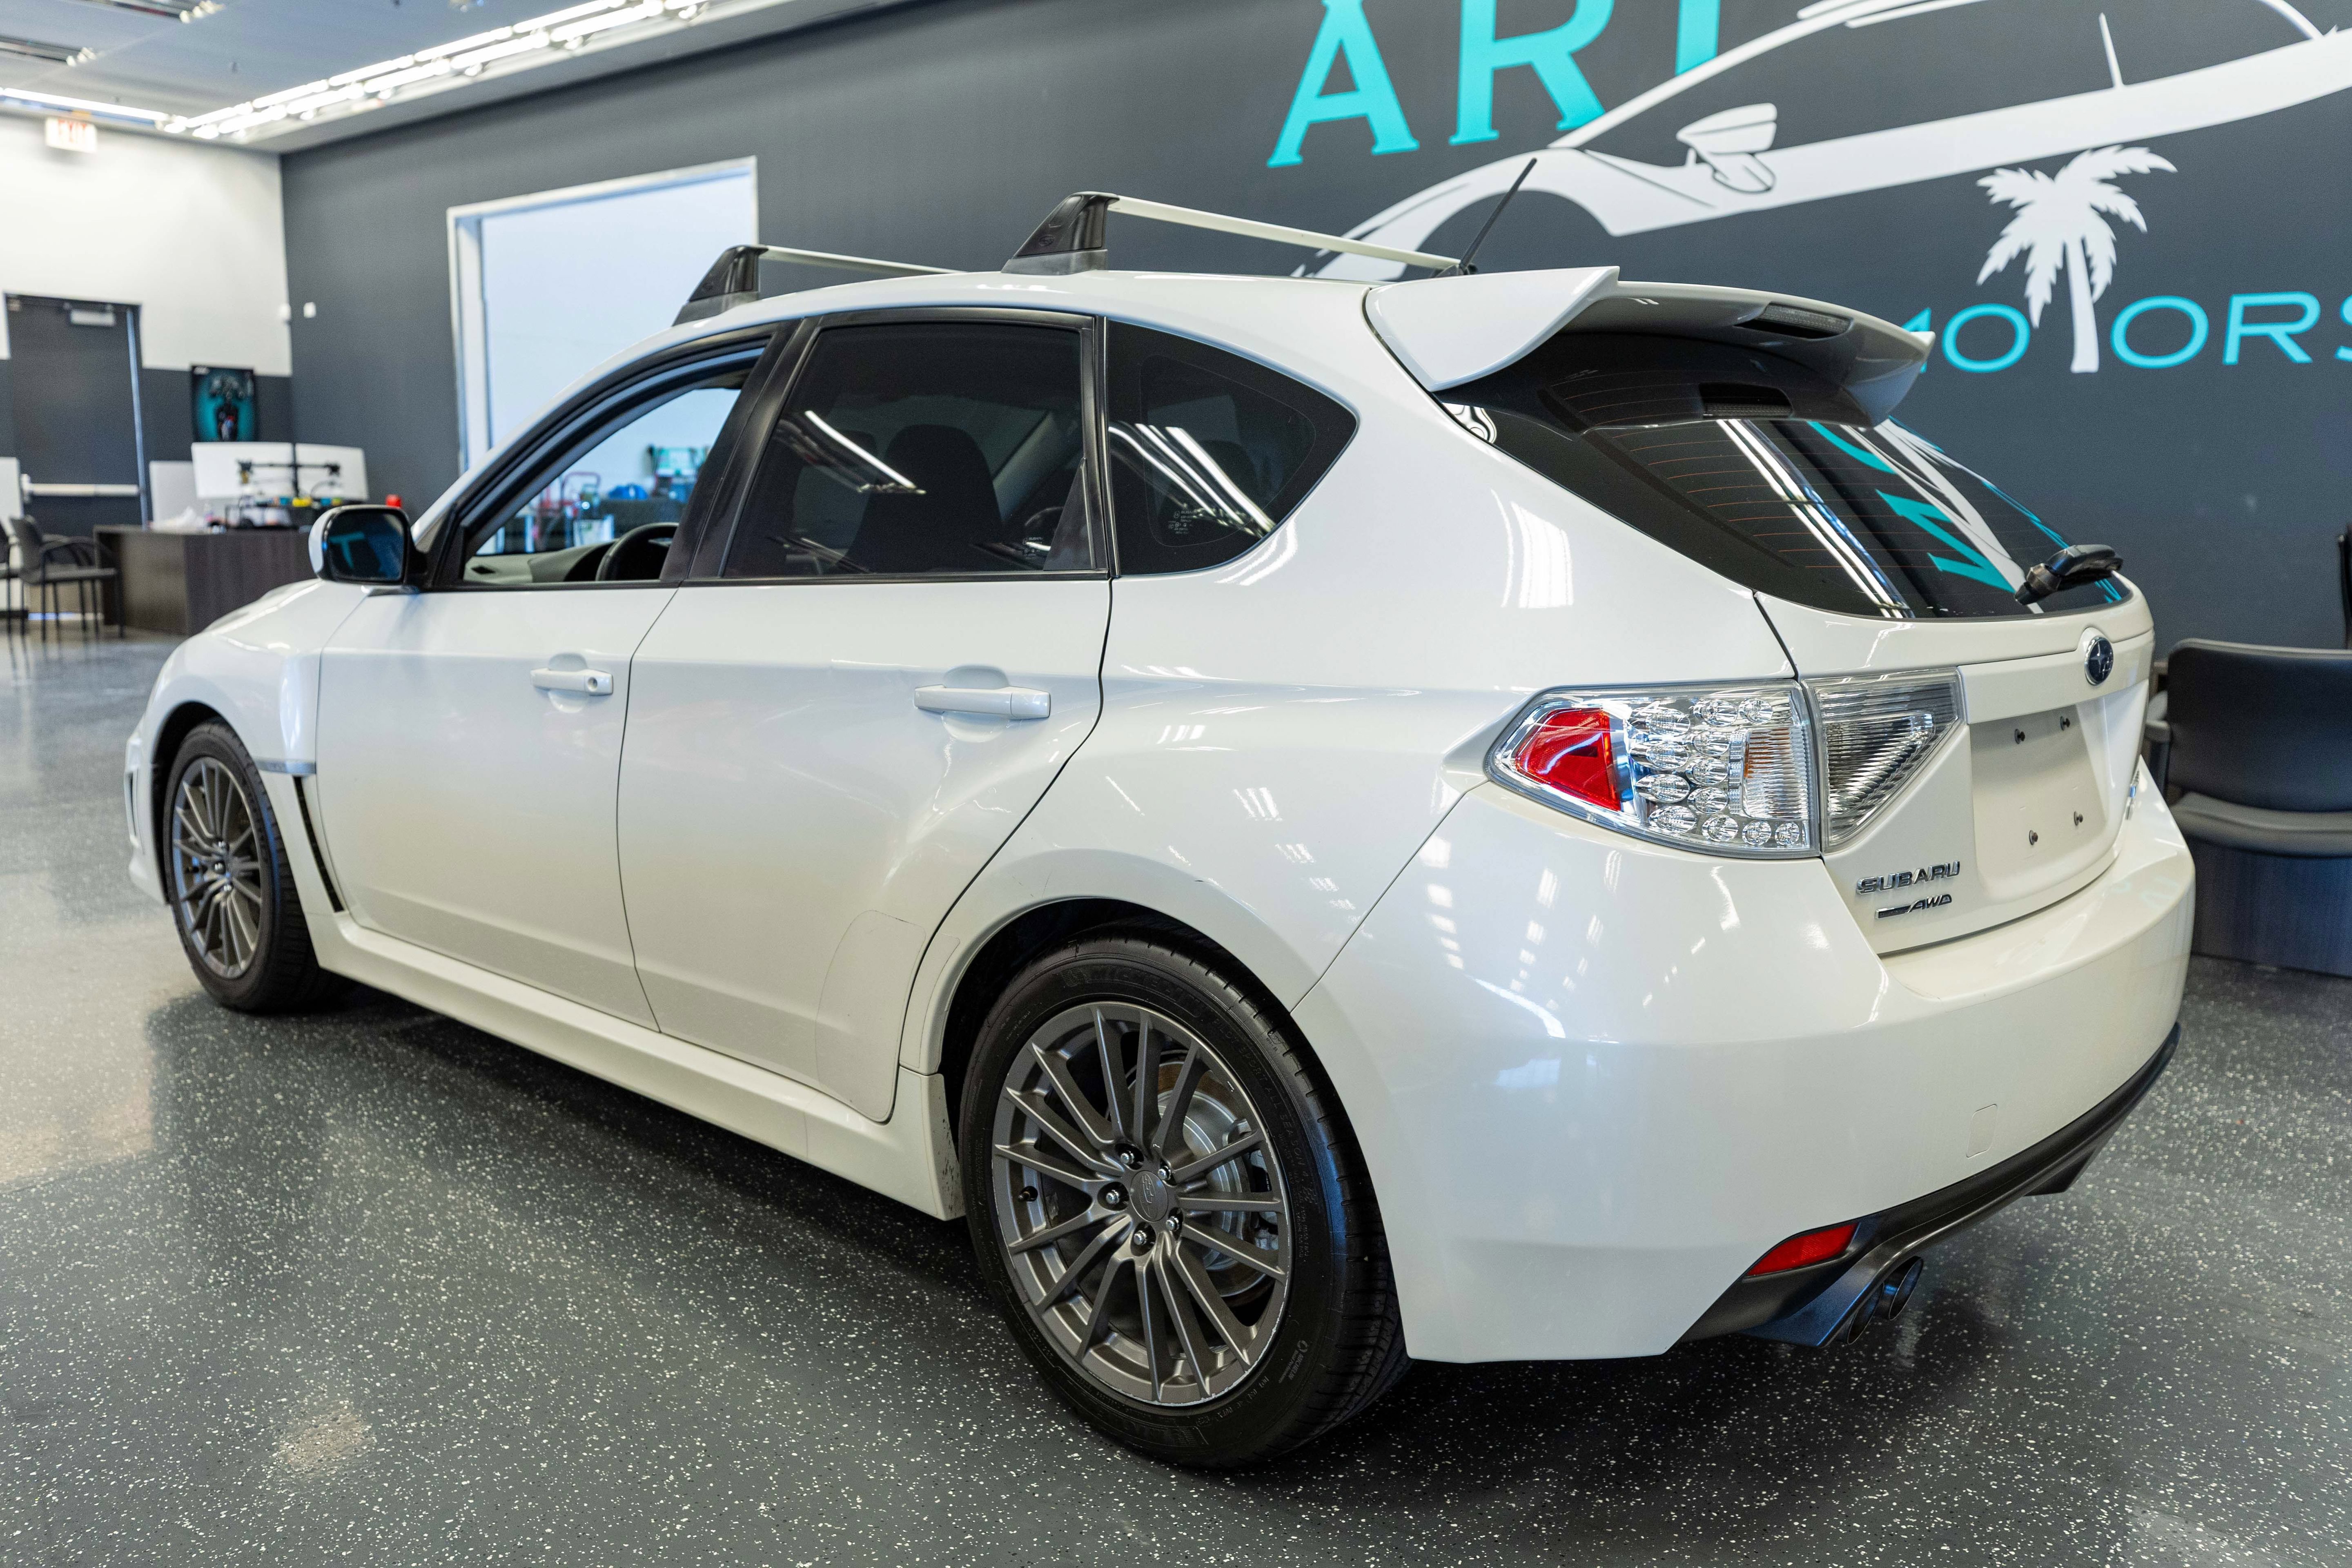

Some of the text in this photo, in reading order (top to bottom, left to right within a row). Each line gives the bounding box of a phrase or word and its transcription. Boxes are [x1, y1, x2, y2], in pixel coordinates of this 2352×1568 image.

[1856, 860, 1960, 894] SUBARU
[1906, 894, 1952, 913] AWD
[1238, 1044, 1268, 1082] SPORT
[1288, 1352, 1304, 1381] MICHELIN
